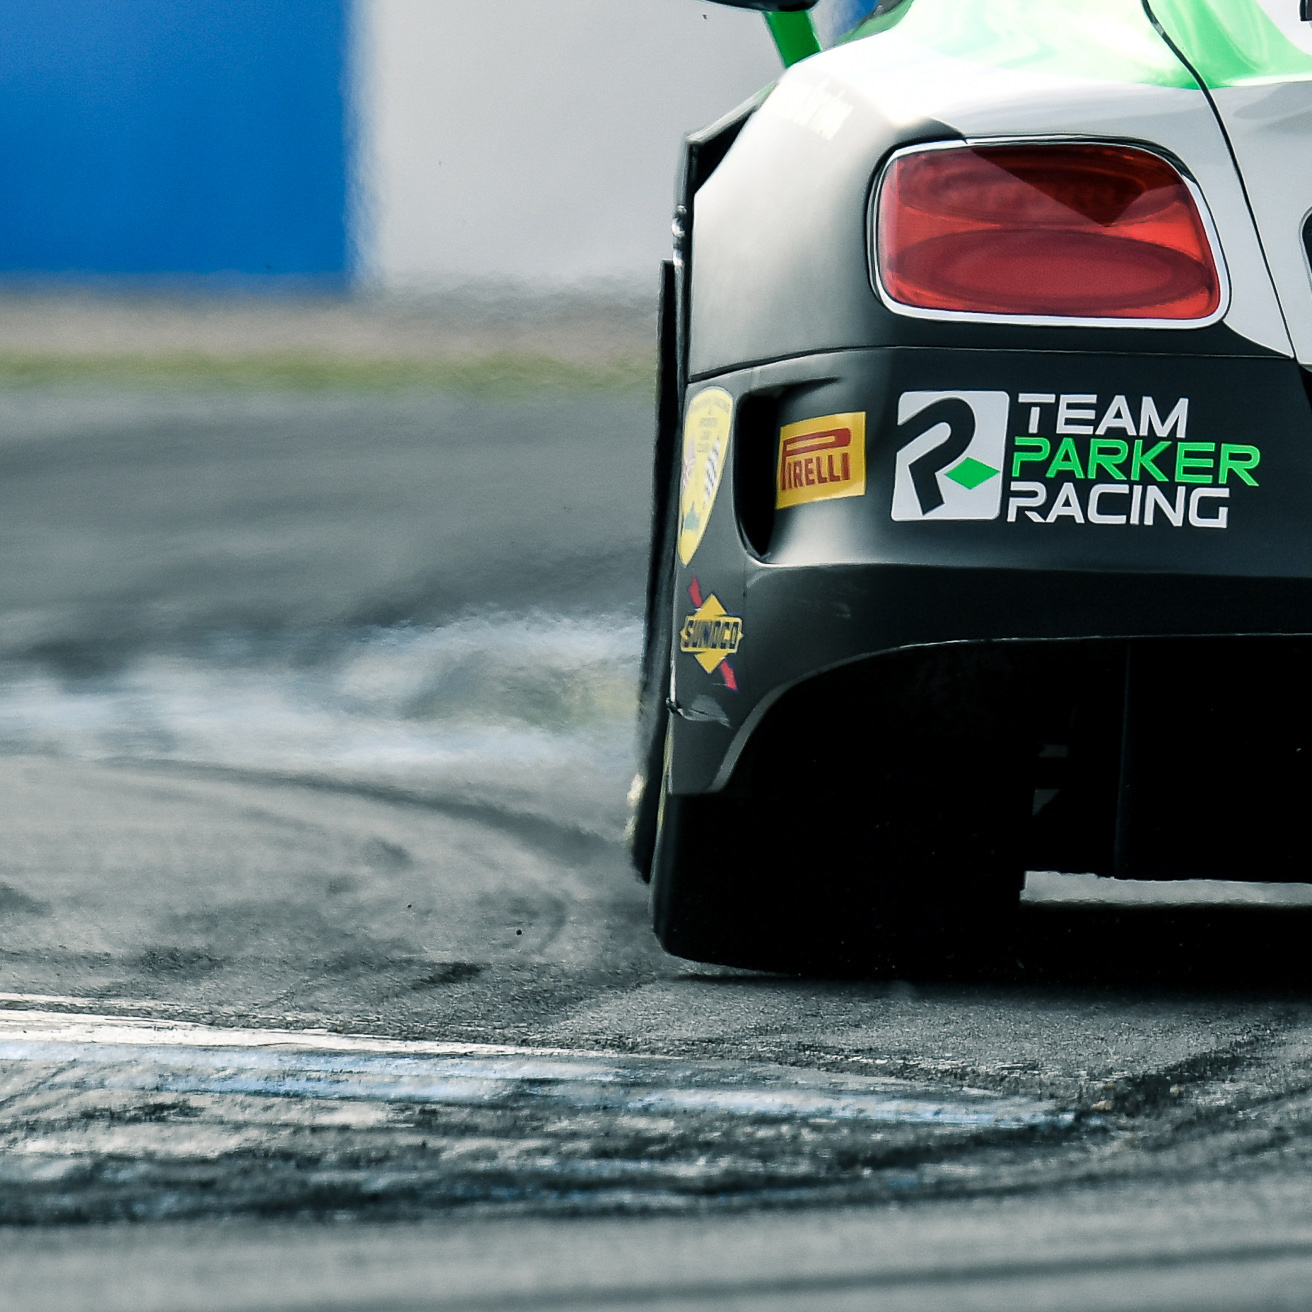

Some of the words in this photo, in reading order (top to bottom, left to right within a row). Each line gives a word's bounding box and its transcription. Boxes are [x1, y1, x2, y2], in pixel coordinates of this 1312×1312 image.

[1017, 393, 1189, 439] TEAM
[781, 427, 852, 491] PIRELLI
[1011, 435, 1261, 487] PARKER
[1006, 481, 1230, 529] RACING
